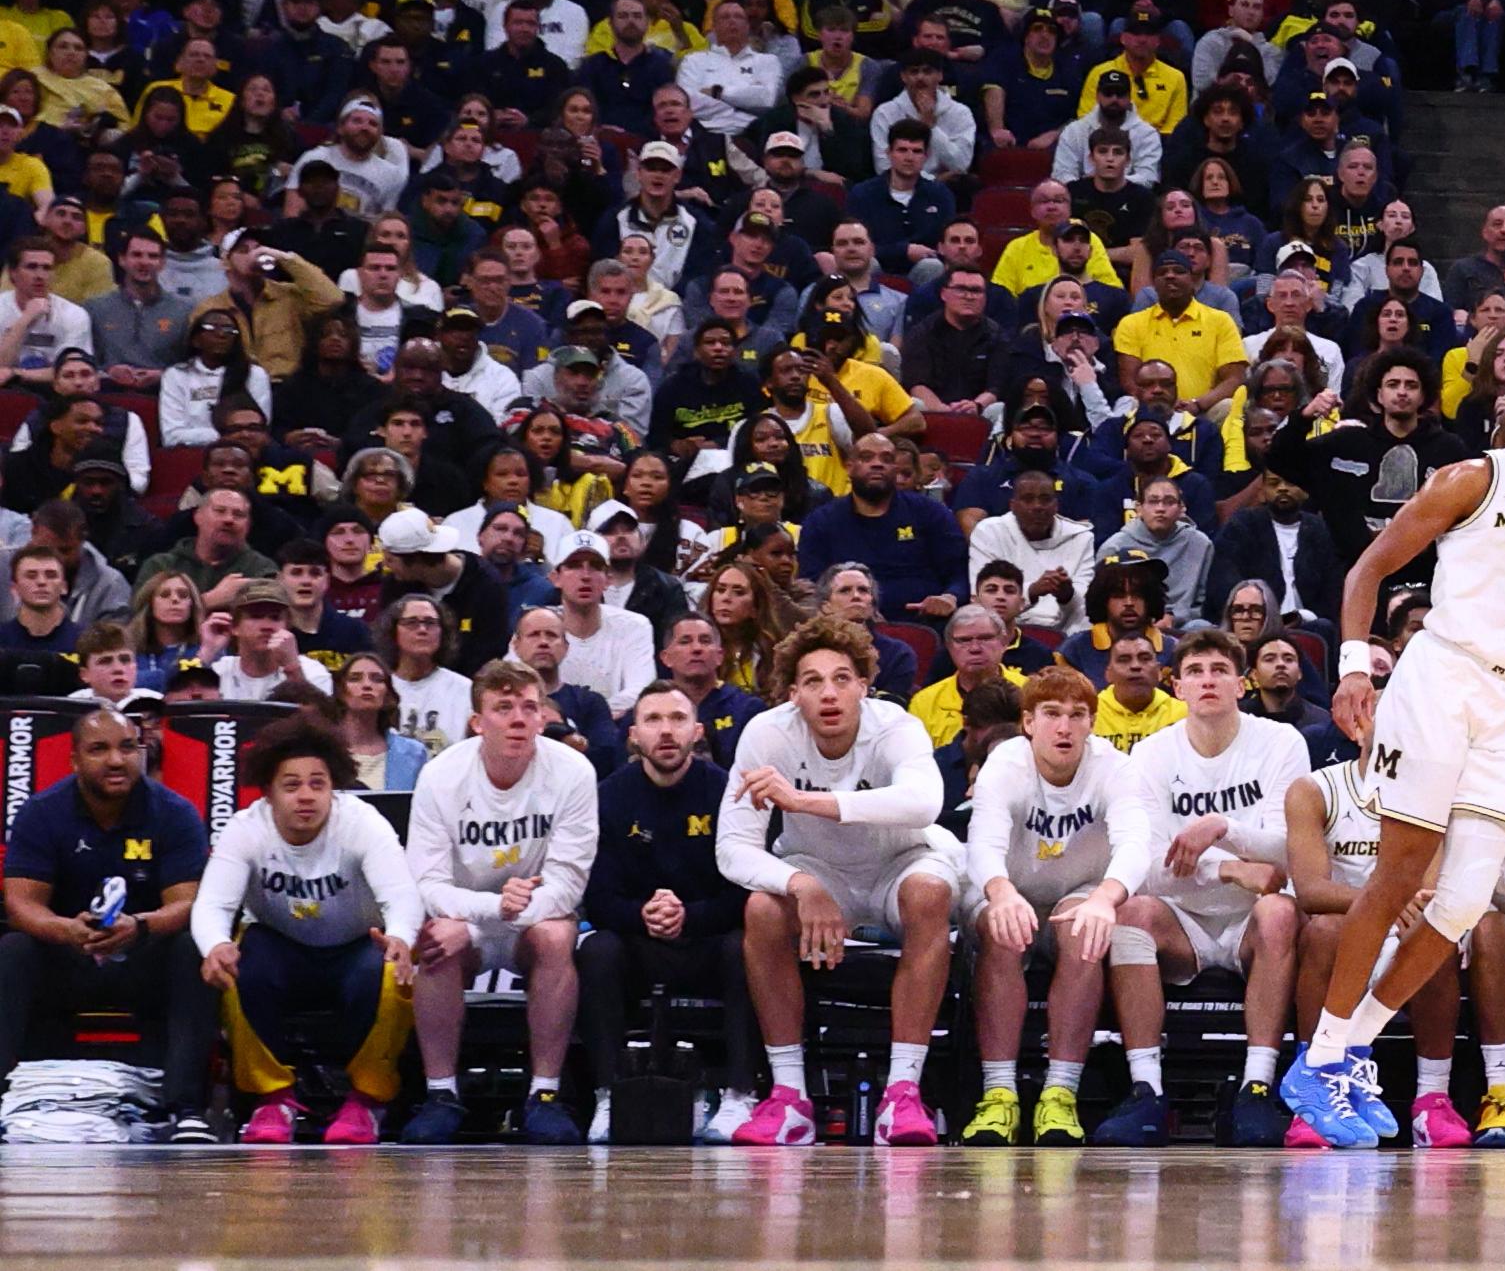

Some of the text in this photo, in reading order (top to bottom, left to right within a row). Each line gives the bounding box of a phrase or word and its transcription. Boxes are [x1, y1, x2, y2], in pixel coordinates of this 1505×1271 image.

[1109, 73, 1119, 81] C
[257, 464, 306, 495] M
[897, 526, 914, 541] M
[714, 714, 733, 730] M
[1374, 744, 1403, 780] M
[1171, 779, 1264, 817] LOCK IT IN
[459, 814, 555, 847] LOCK IT IN
[687, 814, 711, 836] M
[124, 838, 152, 860] M
[493, 847, 521, 870] M
[1036, 839, 1063, 860] M
[1334, 841, 1380, 857] MICH
[1166, 1002, 1179, 1010] THE
[1181, 1002, 1201, 1010] ROAD
[1202, 1002, 1213, 1010] TO
[1215, 1002, 1228, 1010] THE
